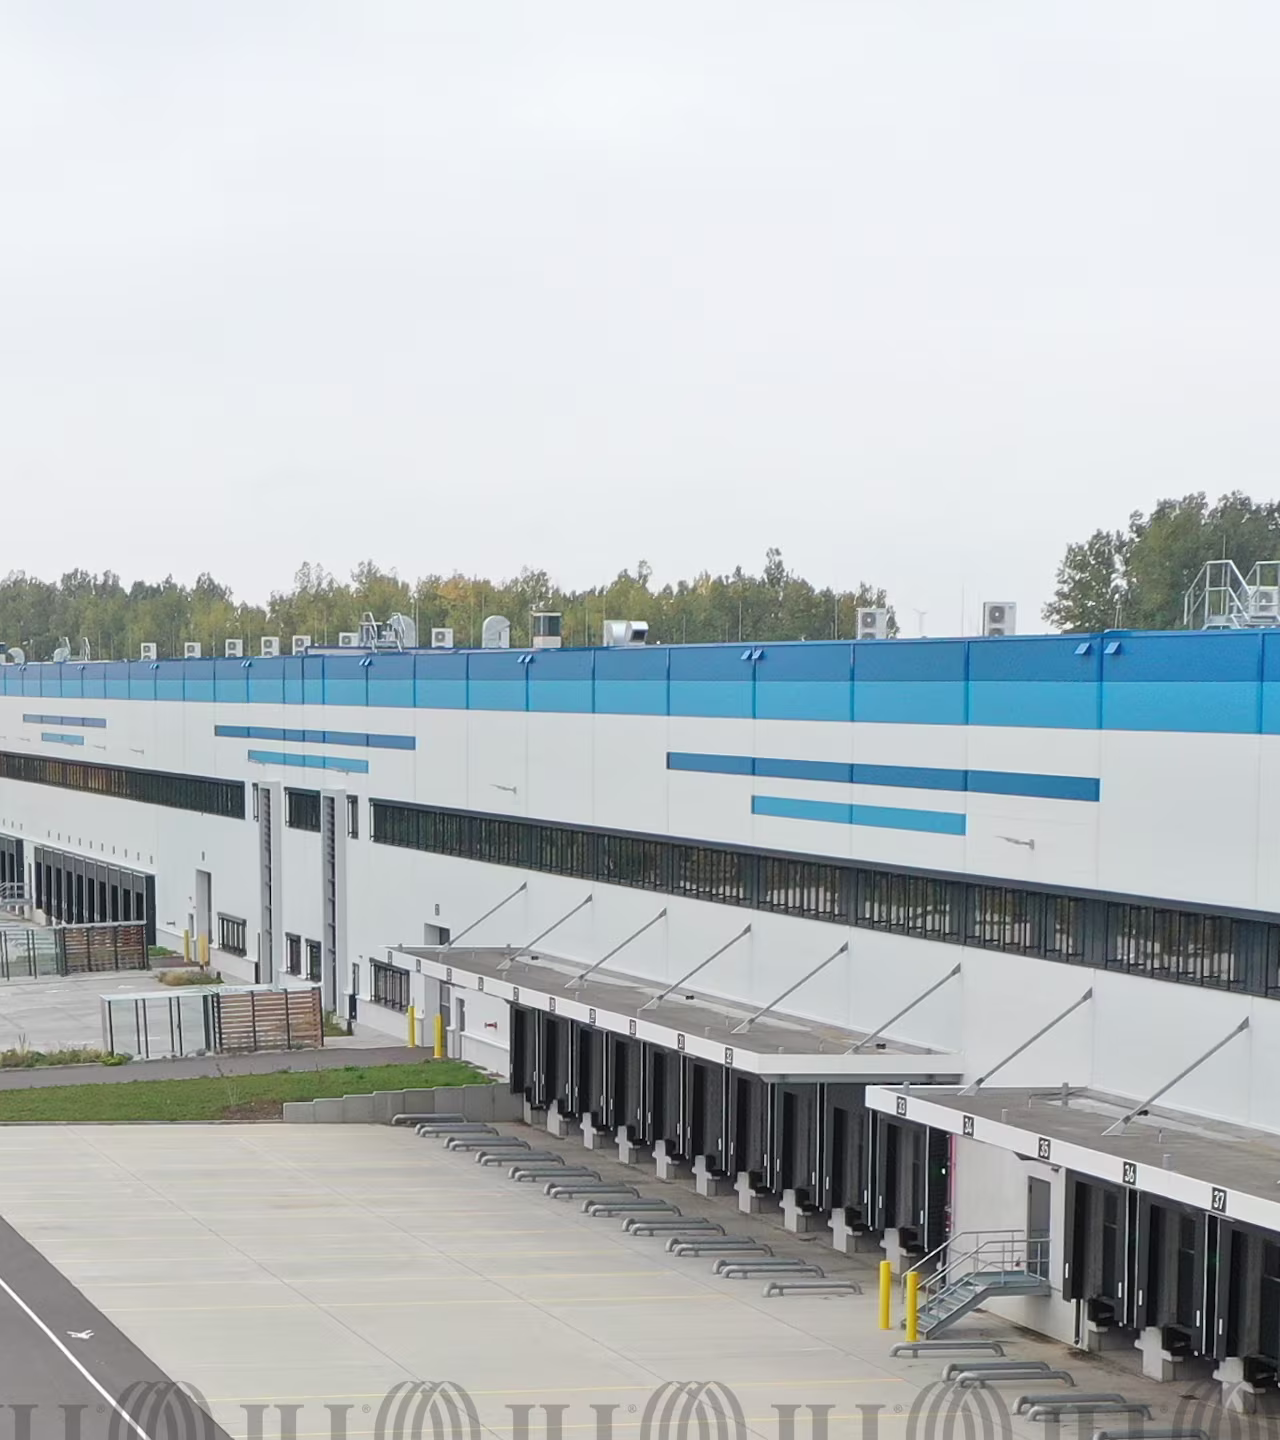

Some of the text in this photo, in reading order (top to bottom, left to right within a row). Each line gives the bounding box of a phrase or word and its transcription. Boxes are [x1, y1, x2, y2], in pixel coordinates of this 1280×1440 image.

[964, 1117, 973, 1134] 34
[1039, 1139, 1049, 1158] 35
[1124, 1164, 1135, 1183] 36
[1213, 1190, 1225, 1210] 37
